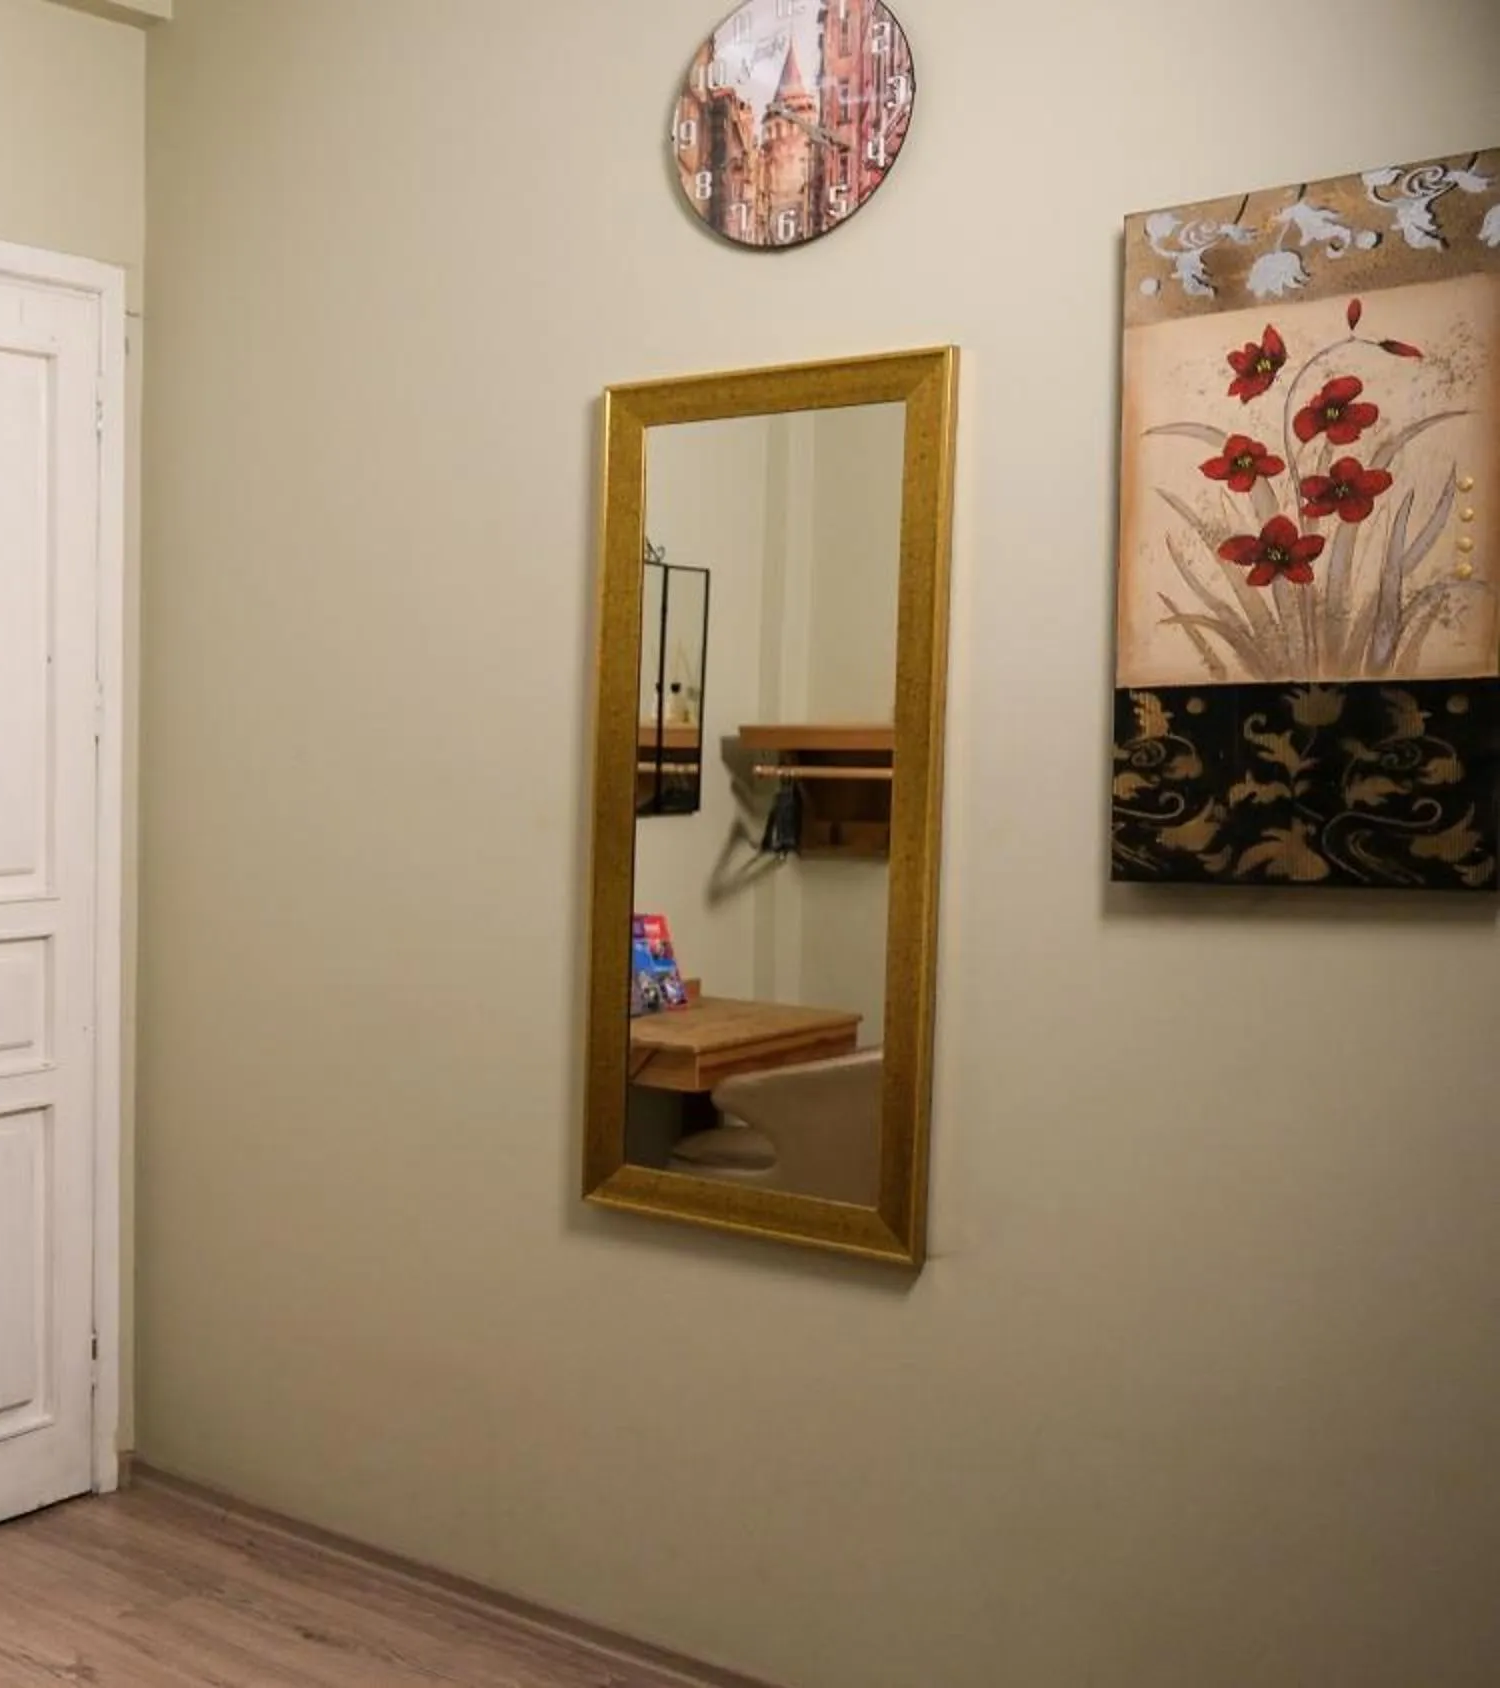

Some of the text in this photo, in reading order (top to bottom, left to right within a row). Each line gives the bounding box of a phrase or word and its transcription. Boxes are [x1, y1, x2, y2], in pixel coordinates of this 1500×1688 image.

[871, 21, 891, 54] 2
[887, 75, 908, 109] 3
[679, 120, 697, 151] 9
[866, 130, 886, 168] 4
[695, 170, 713, 200] 8
[828, 184, 849, 218] 5
[728, 202, 748, 232] 7
[777, 208, 797, 242] 6
